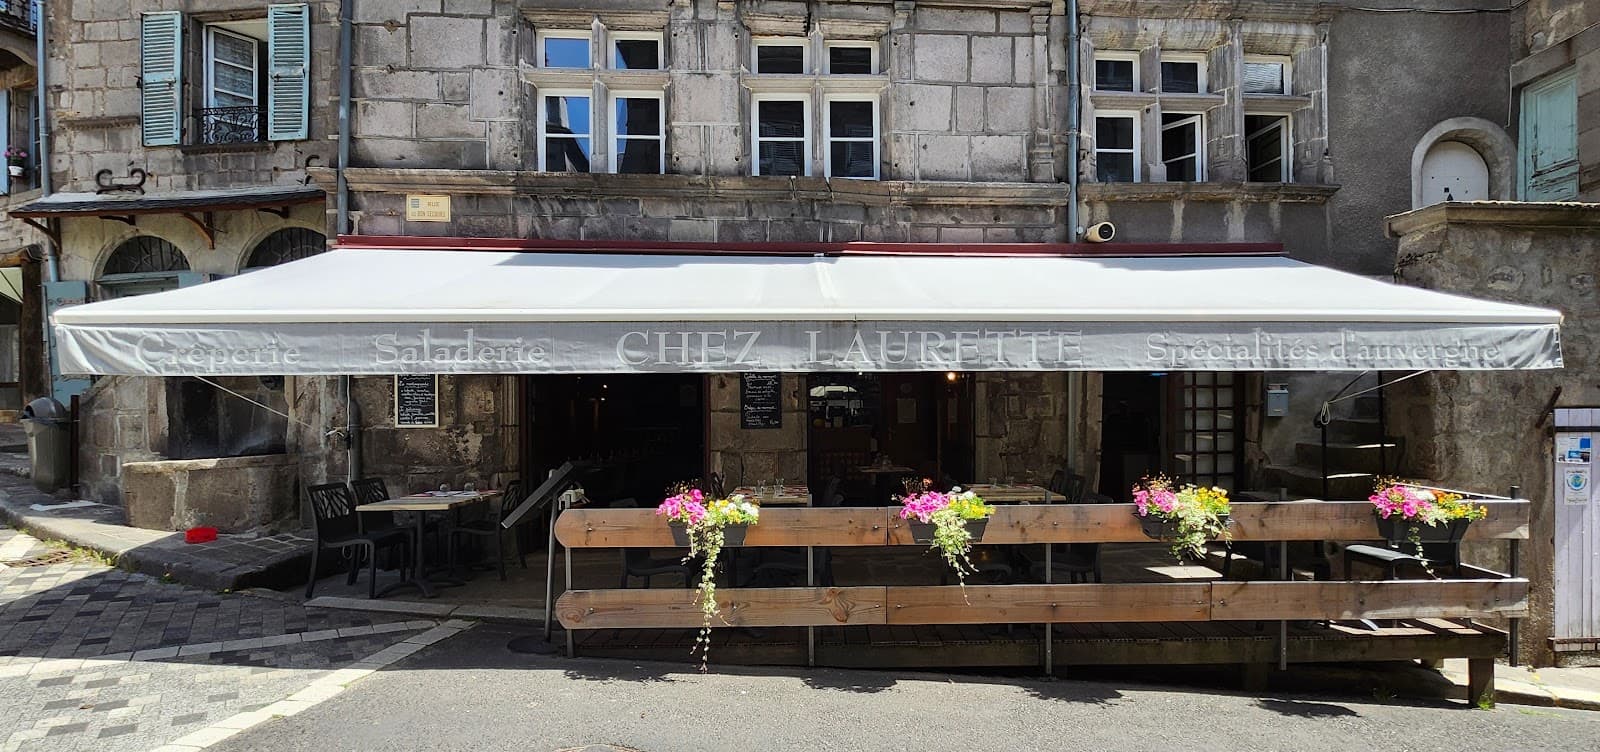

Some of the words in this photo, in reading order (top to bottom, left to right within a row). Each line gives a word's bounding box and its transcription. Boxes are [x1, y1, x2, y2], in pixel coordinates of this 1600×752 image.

[375, 328, 546, 364] Saladerie
[615, 329, 762, 366] CHEZ
[804, 328, 1083, 366] LAURETTE
[1146, 327, 1319, 368] Spécialités
